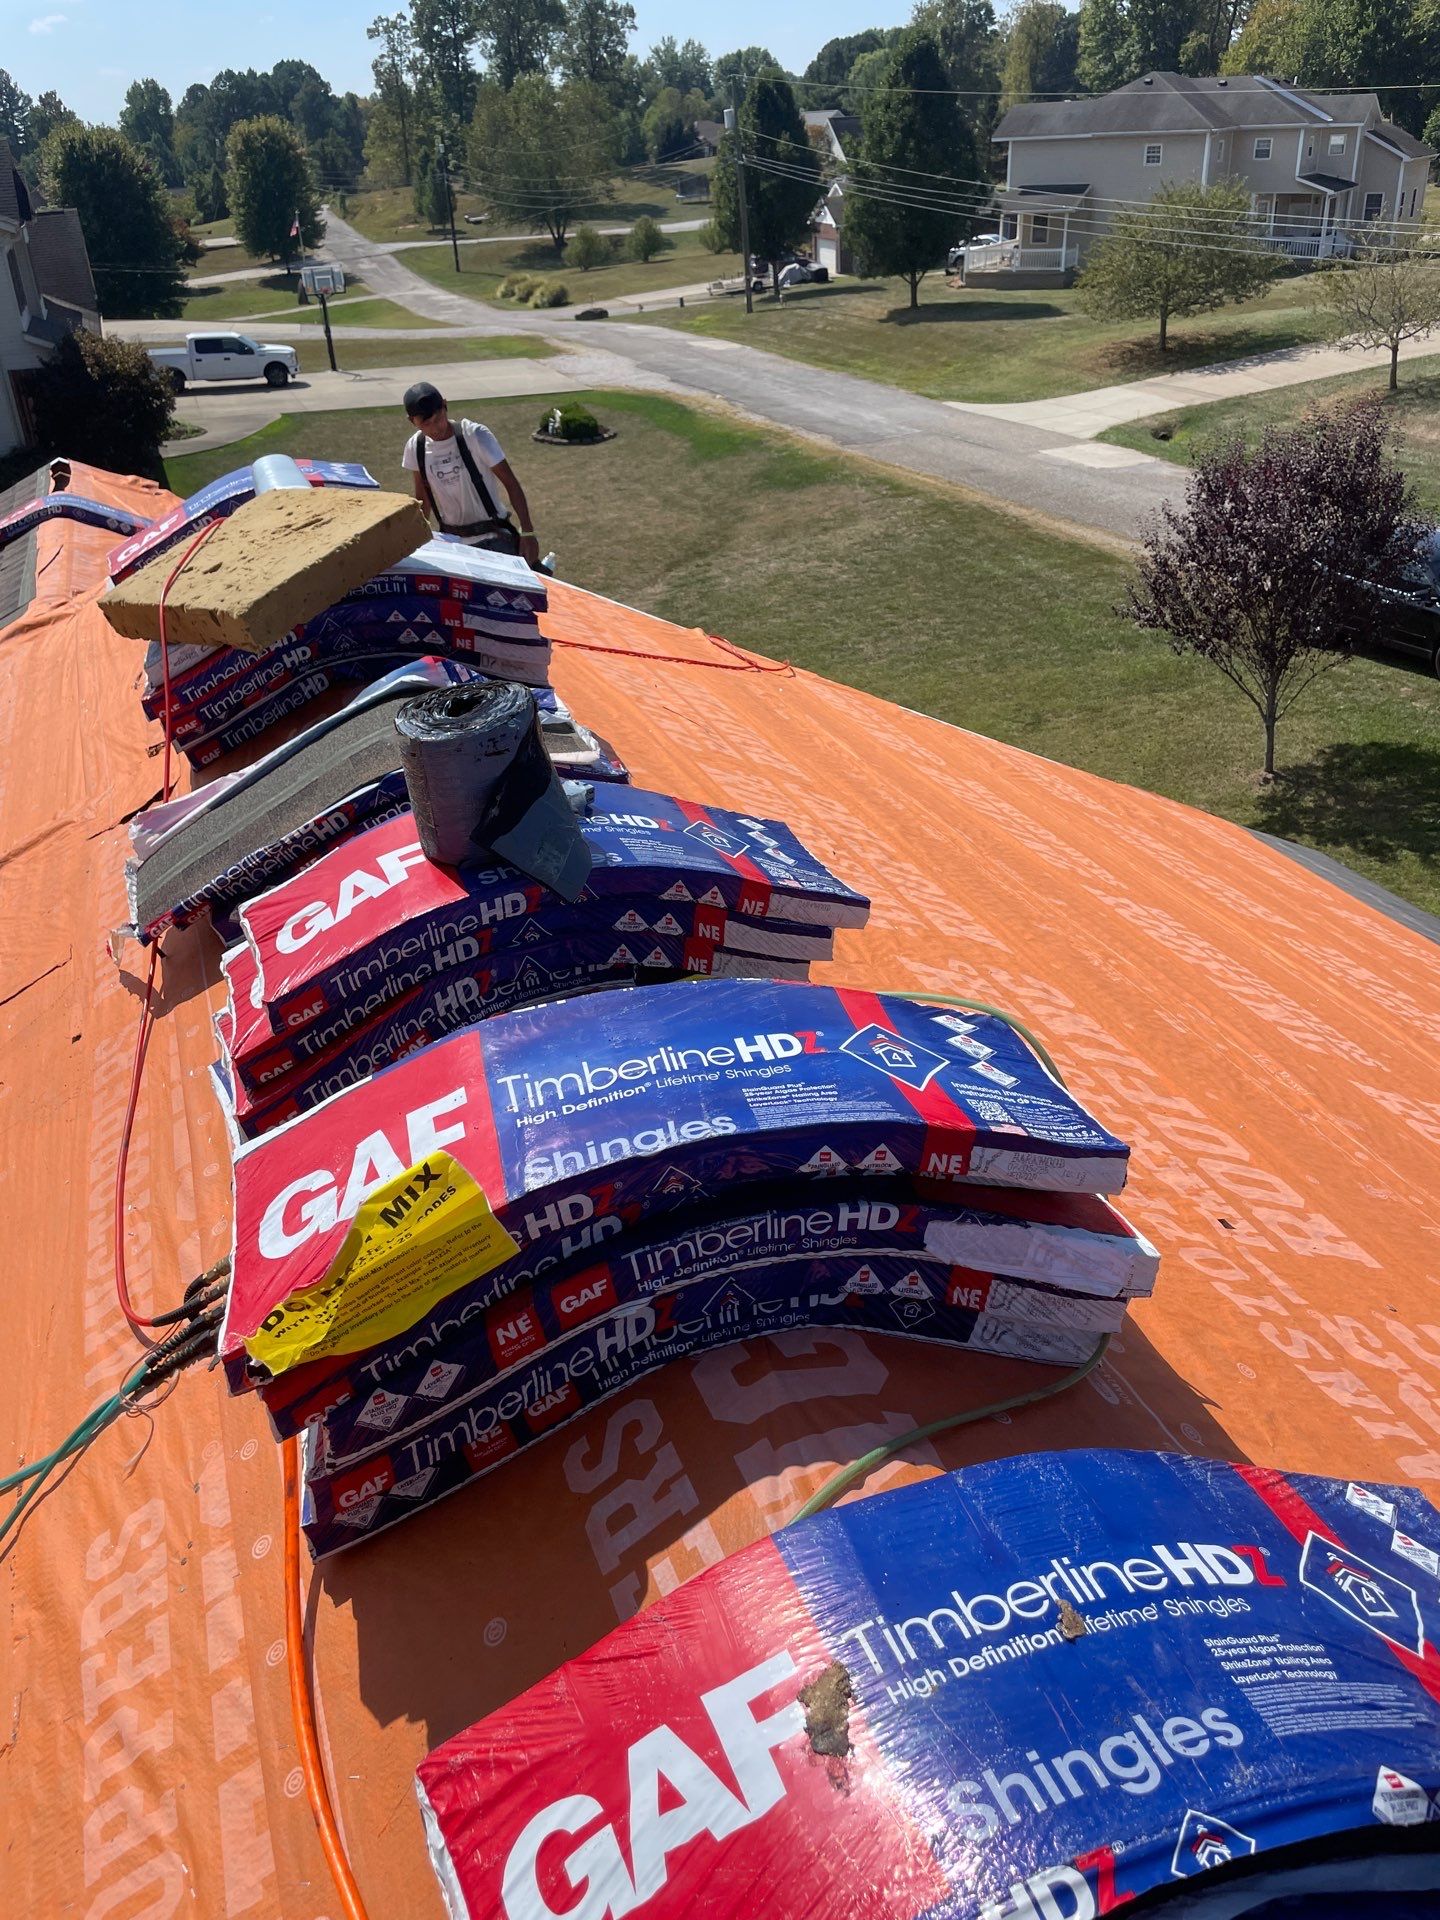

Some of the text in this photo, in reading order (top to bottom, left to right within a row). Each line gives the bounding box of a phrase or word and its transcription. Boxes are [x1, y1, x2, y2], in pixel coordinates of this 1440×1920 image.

[116, 513, 180, 562] GAF
[452, 589, 469, 600] NE
[455, 638, 472, 650] NE
[176, 720, 199, 735] GAF
[201, 749, 223, 765] GAF
[275, 841, 426, 954] GAF
[742, 900, 765, 916] NE
[150, 916, 174, 938] GAF
[698, 924, 720, 941] NE
[687, 957, 708, 973] NE
[288, 1000, 325, 1027] GAF
[891, 1051, 903, 1063] 4
[259, 1060, 294, 1083] GAF
[515, 1108, 558, 1128] High
[725, 1063, 792, 1079] Shingles
[989, 968, 1382, 1267] ROOFING
[523, 1114, 738, 1192] Shingles
[928, 1153, 963, 1175] NE
[258, 1086, 469, 1260] GAF
[378, 1161, 443, 1230] MIX
[801, 1234, 858, 1249] Shingles
[559, 1278, 609, 1314] GAF
[952, 1288, 983, 1311] NE
[495, 1312, 534, 1346] NE
[527, 1384, 571, 1418] GAF
[338, 1471, 390, 1507] GAF
[1362, 1586, 1377, 1605] 4
[886, 1664, 948, 1704] High
[1162, 1593, 1251, 1621] Shingles
[1203, 1635, 1259, 1648] StainGuard
[1210, 1645, 1278, 1657] 25-year Algae
[1273, 1656, 1311, 1667] Nailing
[1309, 1656, 1333, 1665] Area
[1281, 1669, 1338, 1680] Technology
[500, 1650, 807, 1920] GAF
[946, 1704, 1246, 1845] Shingles
